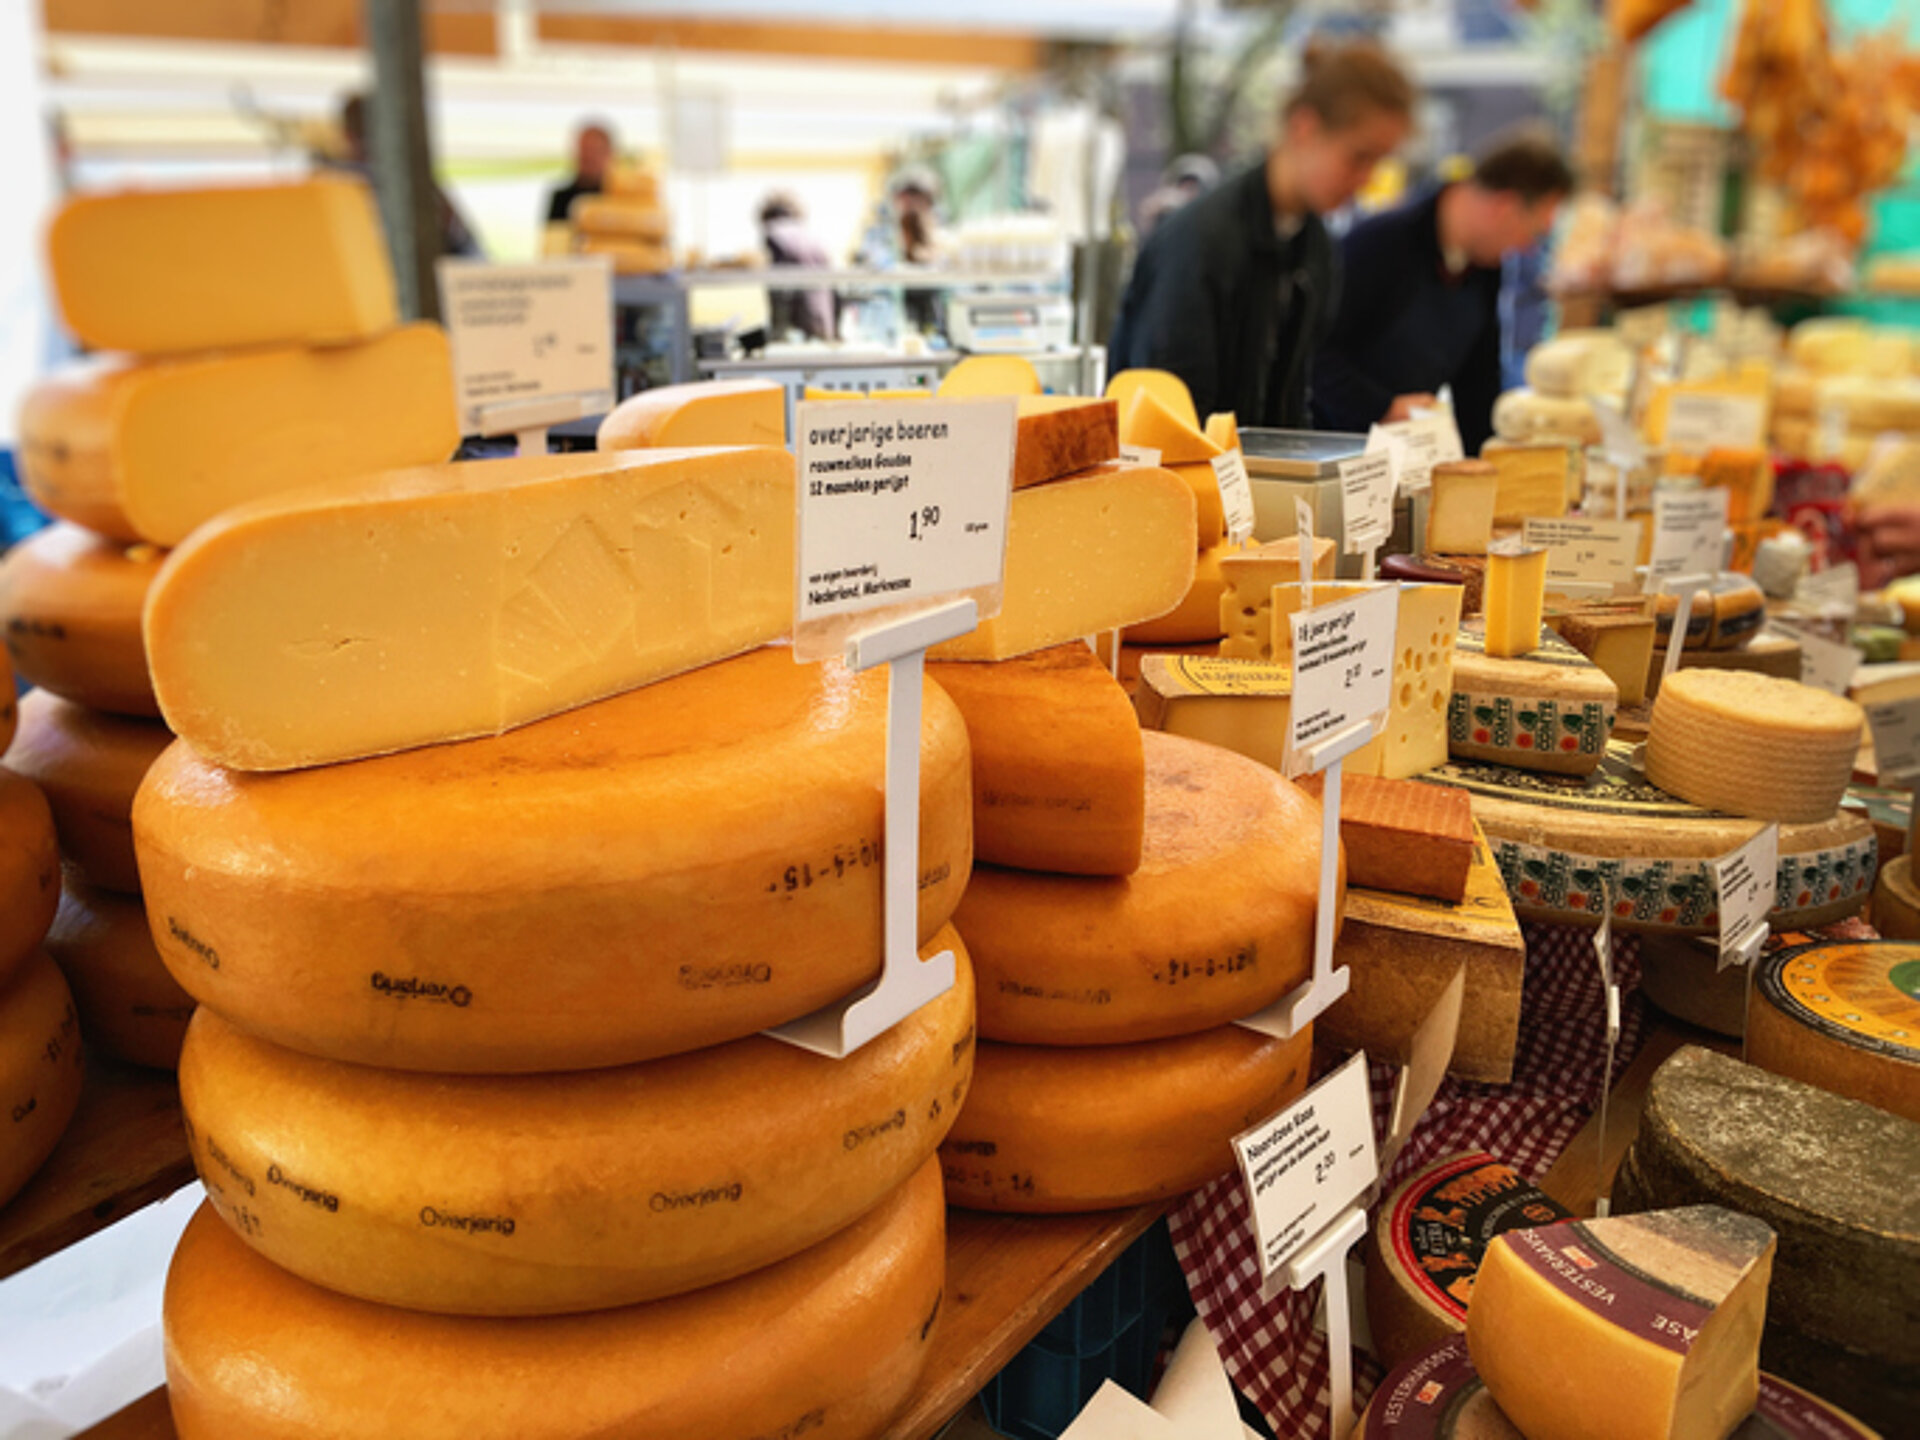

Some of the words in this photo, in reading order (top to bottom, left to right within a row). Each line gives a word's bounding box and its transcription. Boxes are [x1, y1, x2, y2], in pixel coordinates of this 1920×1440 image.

[809, 421, 894, 450] overjarige
[897, 419, 949, 441] boeren
[825, 476, 870, 495] maanden
[872, 474, 909, 496] gerijpt
[420, 1205, 516, 1237] Overjarig
